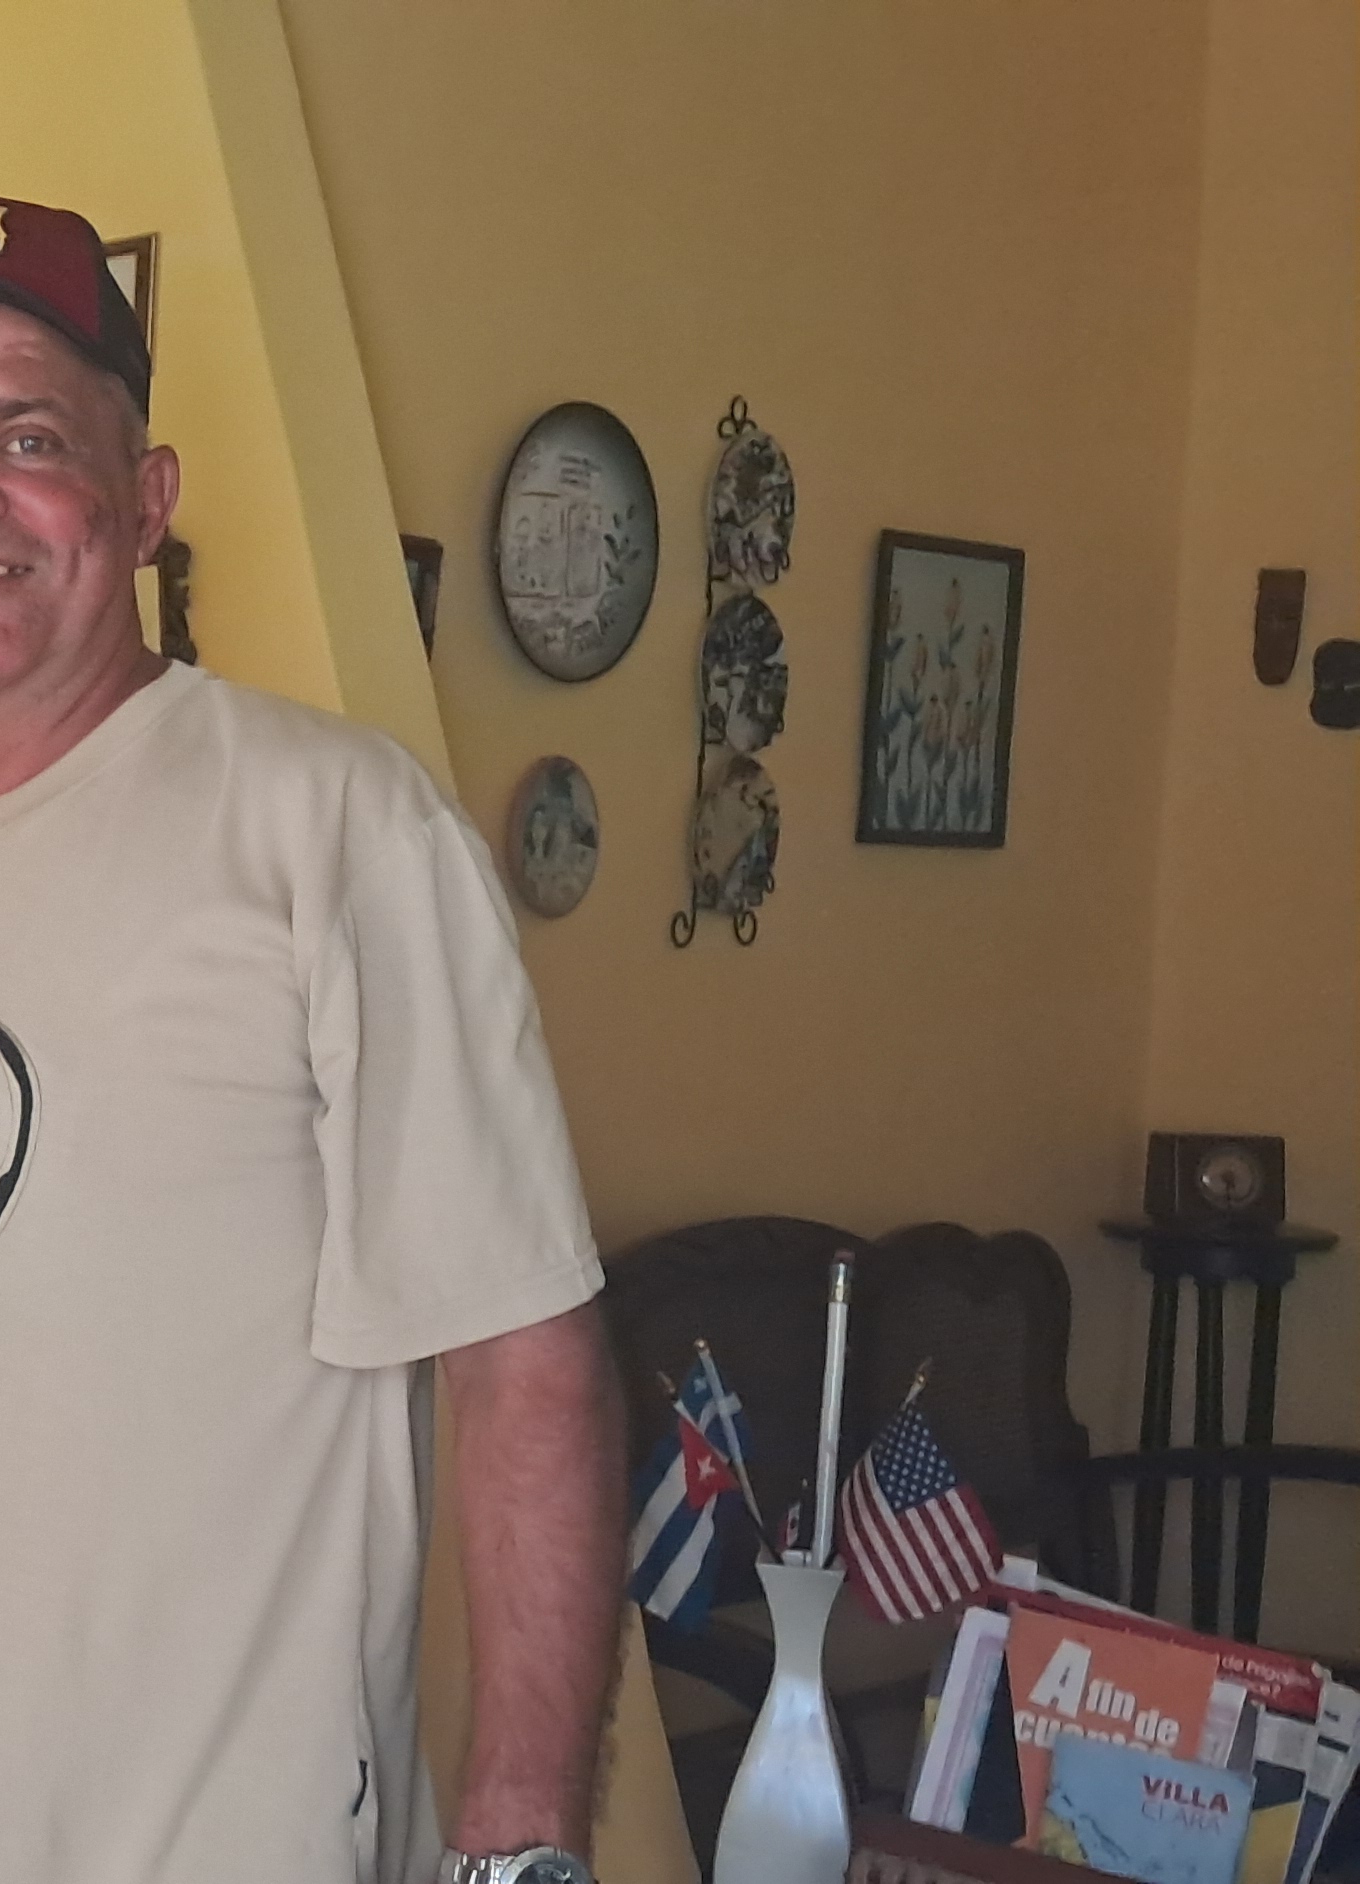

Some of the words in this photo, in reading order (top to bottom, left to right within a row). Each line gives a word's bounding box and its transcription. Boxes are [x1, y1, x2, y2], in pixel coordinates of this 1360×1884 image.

[1029, 1637, 1092, 1719] A
[1086, 1674, 1137, 1722] fin
[1135, 1707, 1181, 1747] de
[1142, 1775, 1229, 1814] VILLA
[1141, 1800, 1221, 1836] CLARA
